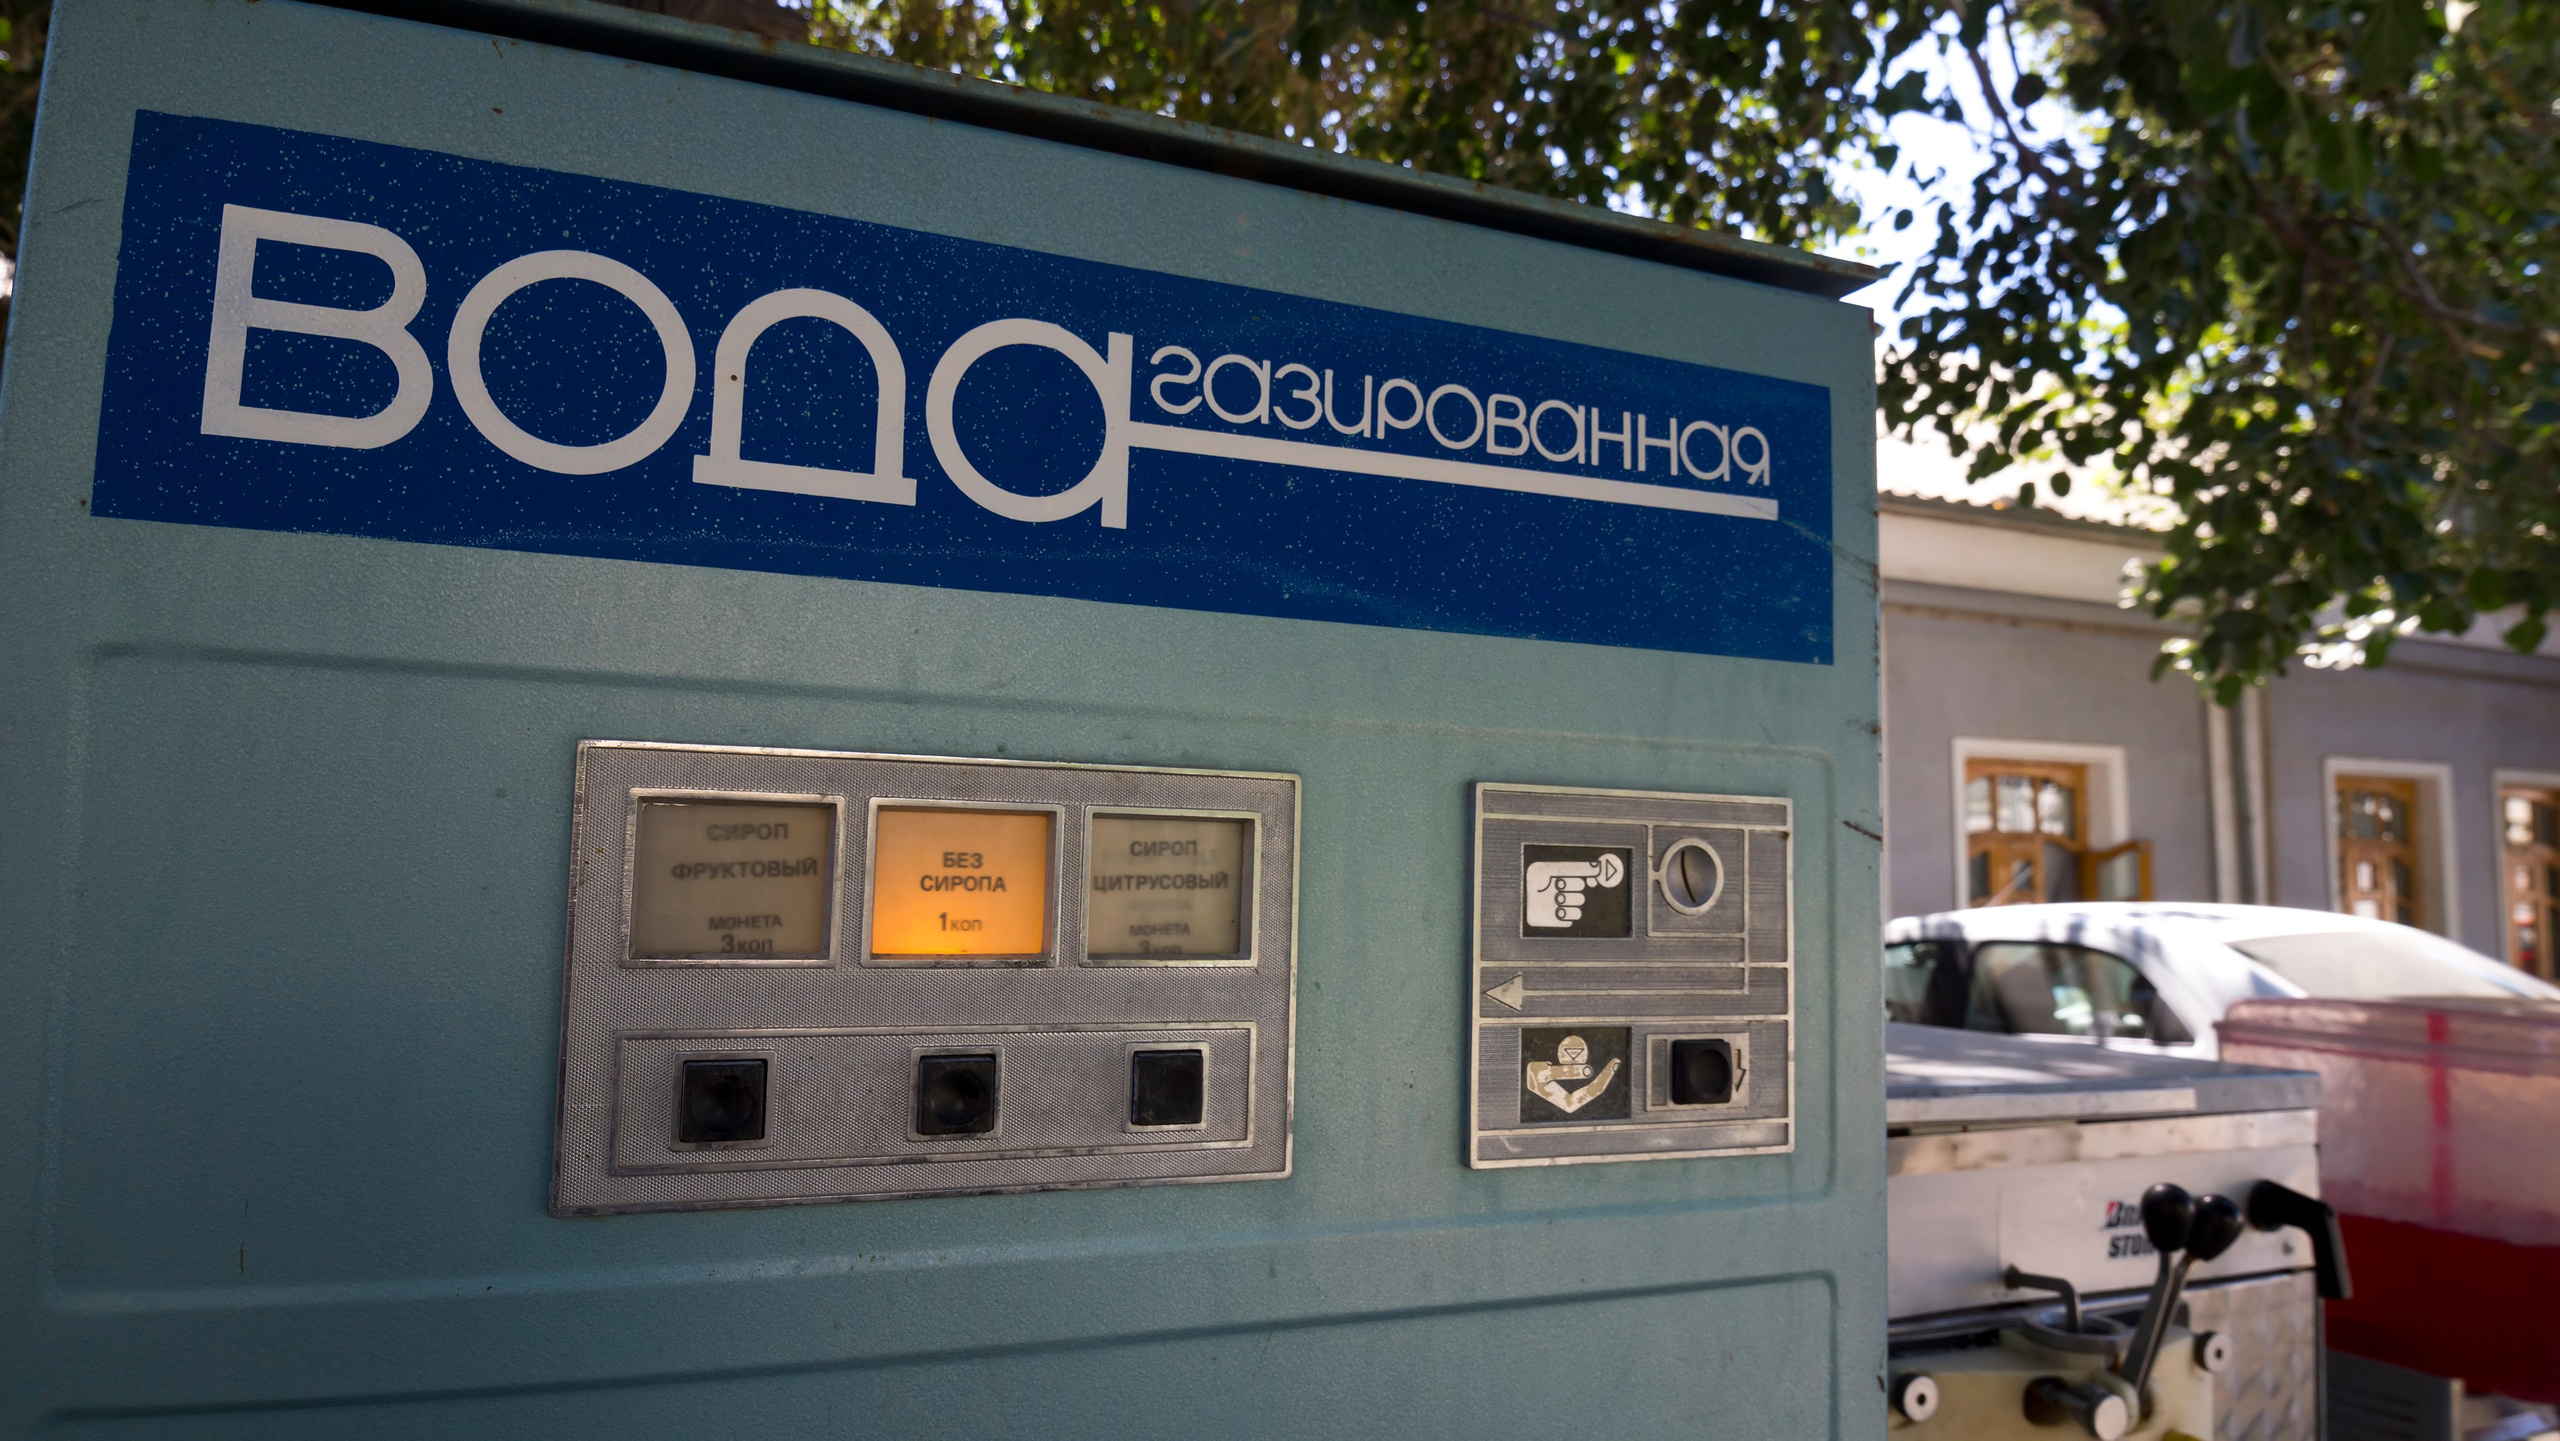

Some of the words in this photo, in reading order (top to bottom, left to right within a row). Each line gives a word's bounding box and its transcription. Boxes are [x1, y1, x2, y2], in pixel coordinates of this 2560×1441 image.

[707, 823, 789, 842] СИРОП
[1130, 841, 1198, 857] СИРОП
[671, 856, 818, 880] ФРУКТОВЫЙ
[943, 852, 984, 869] БЕЗ
[920, 875, 1007, 892] СИРОПА
[1093, 871, 1229, 893] ЦИТРУСОВЫЙ
[708, 914, 783, 931] МОНЕТА
[1129, 923, 1191, 937] МОНЕТА
